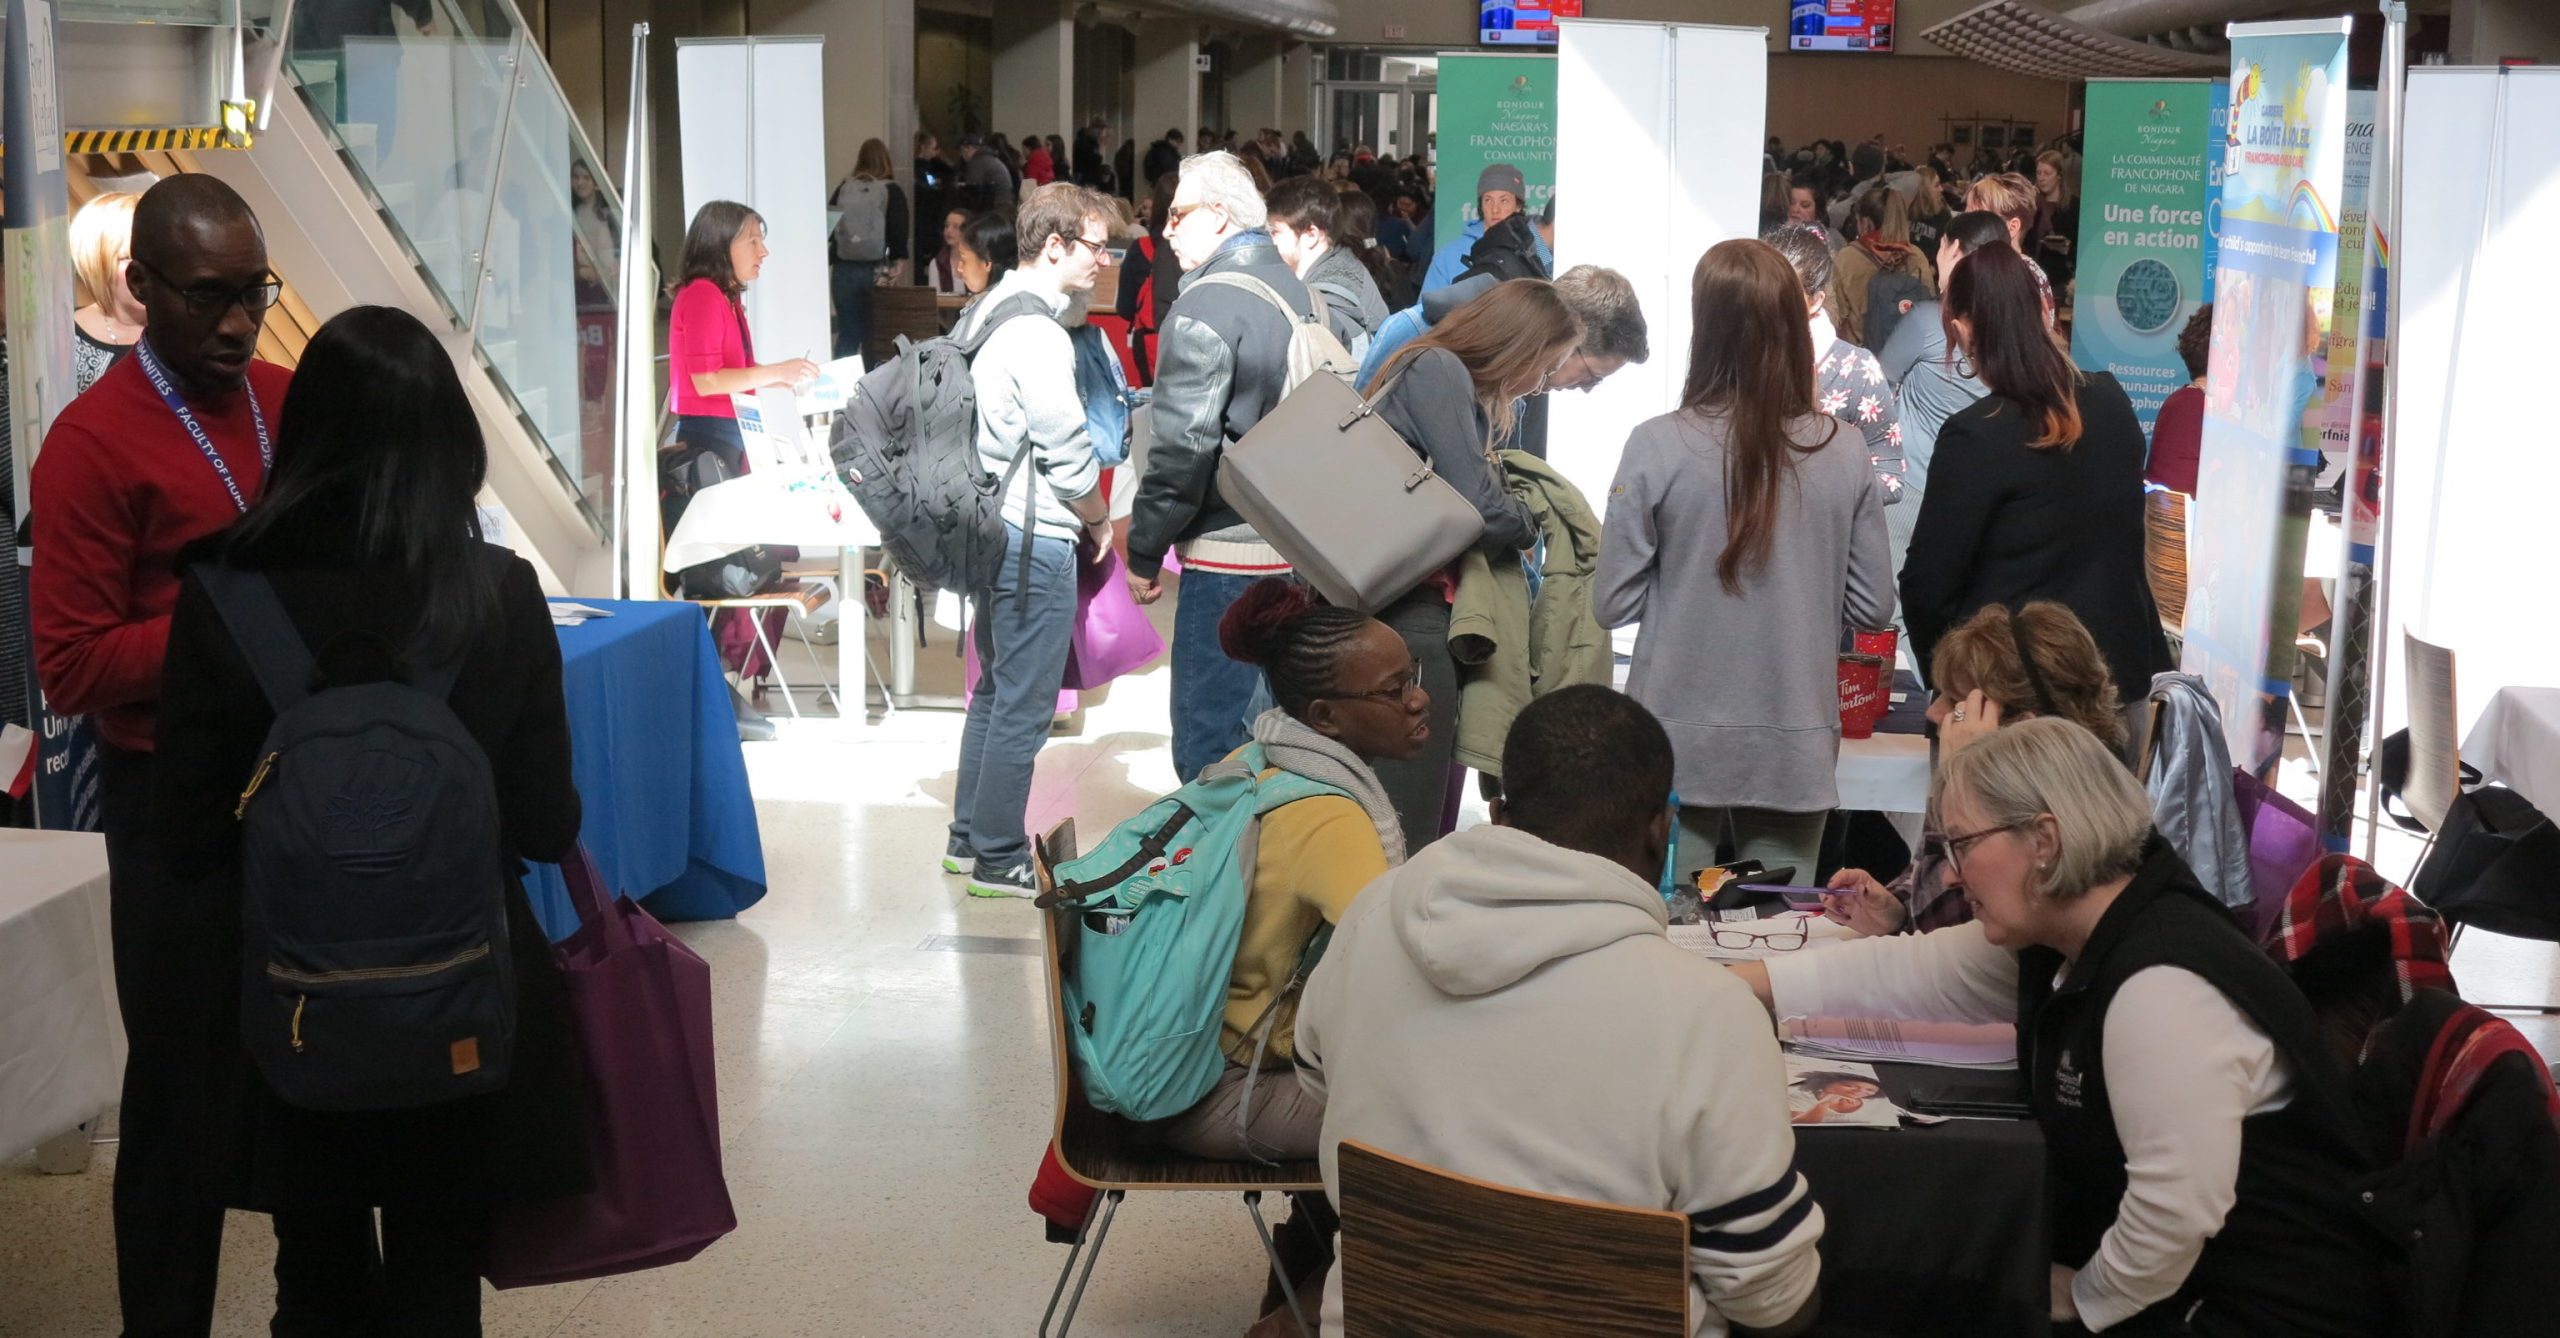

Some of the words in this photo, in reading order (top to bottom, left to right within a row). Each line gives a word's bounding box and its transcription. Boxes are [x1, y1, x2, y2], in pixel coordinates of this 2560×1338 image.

[1492, 122, 1549, 132] NIAGARA'S
[2247, 125, 2257, 145] LA
[1484, 151, 1554, 161] COMMUNITY
[2112, 155, 2124, 164] LA
[2127, 154, 2201, 166] COMMUNAUTÉ
[2111, 168, 2201, 181] FRANCOPHONE
[2125, 183, 2138, 193] DE
[2140, 184, 2185, 194] NIAGARA
[2104, 204, 2144, 223] Une
[2149, 205, 2203, 225] force
[2104, 230, 2128, 246] en
[2134, 229, 2199, 249] action
[2108, 362, 2176, 379] Ressources
[176, 405, 218, 456] FACULTY
[213, 458, 229, 478] OF
[1838, 679, 1861, 695] Tim
